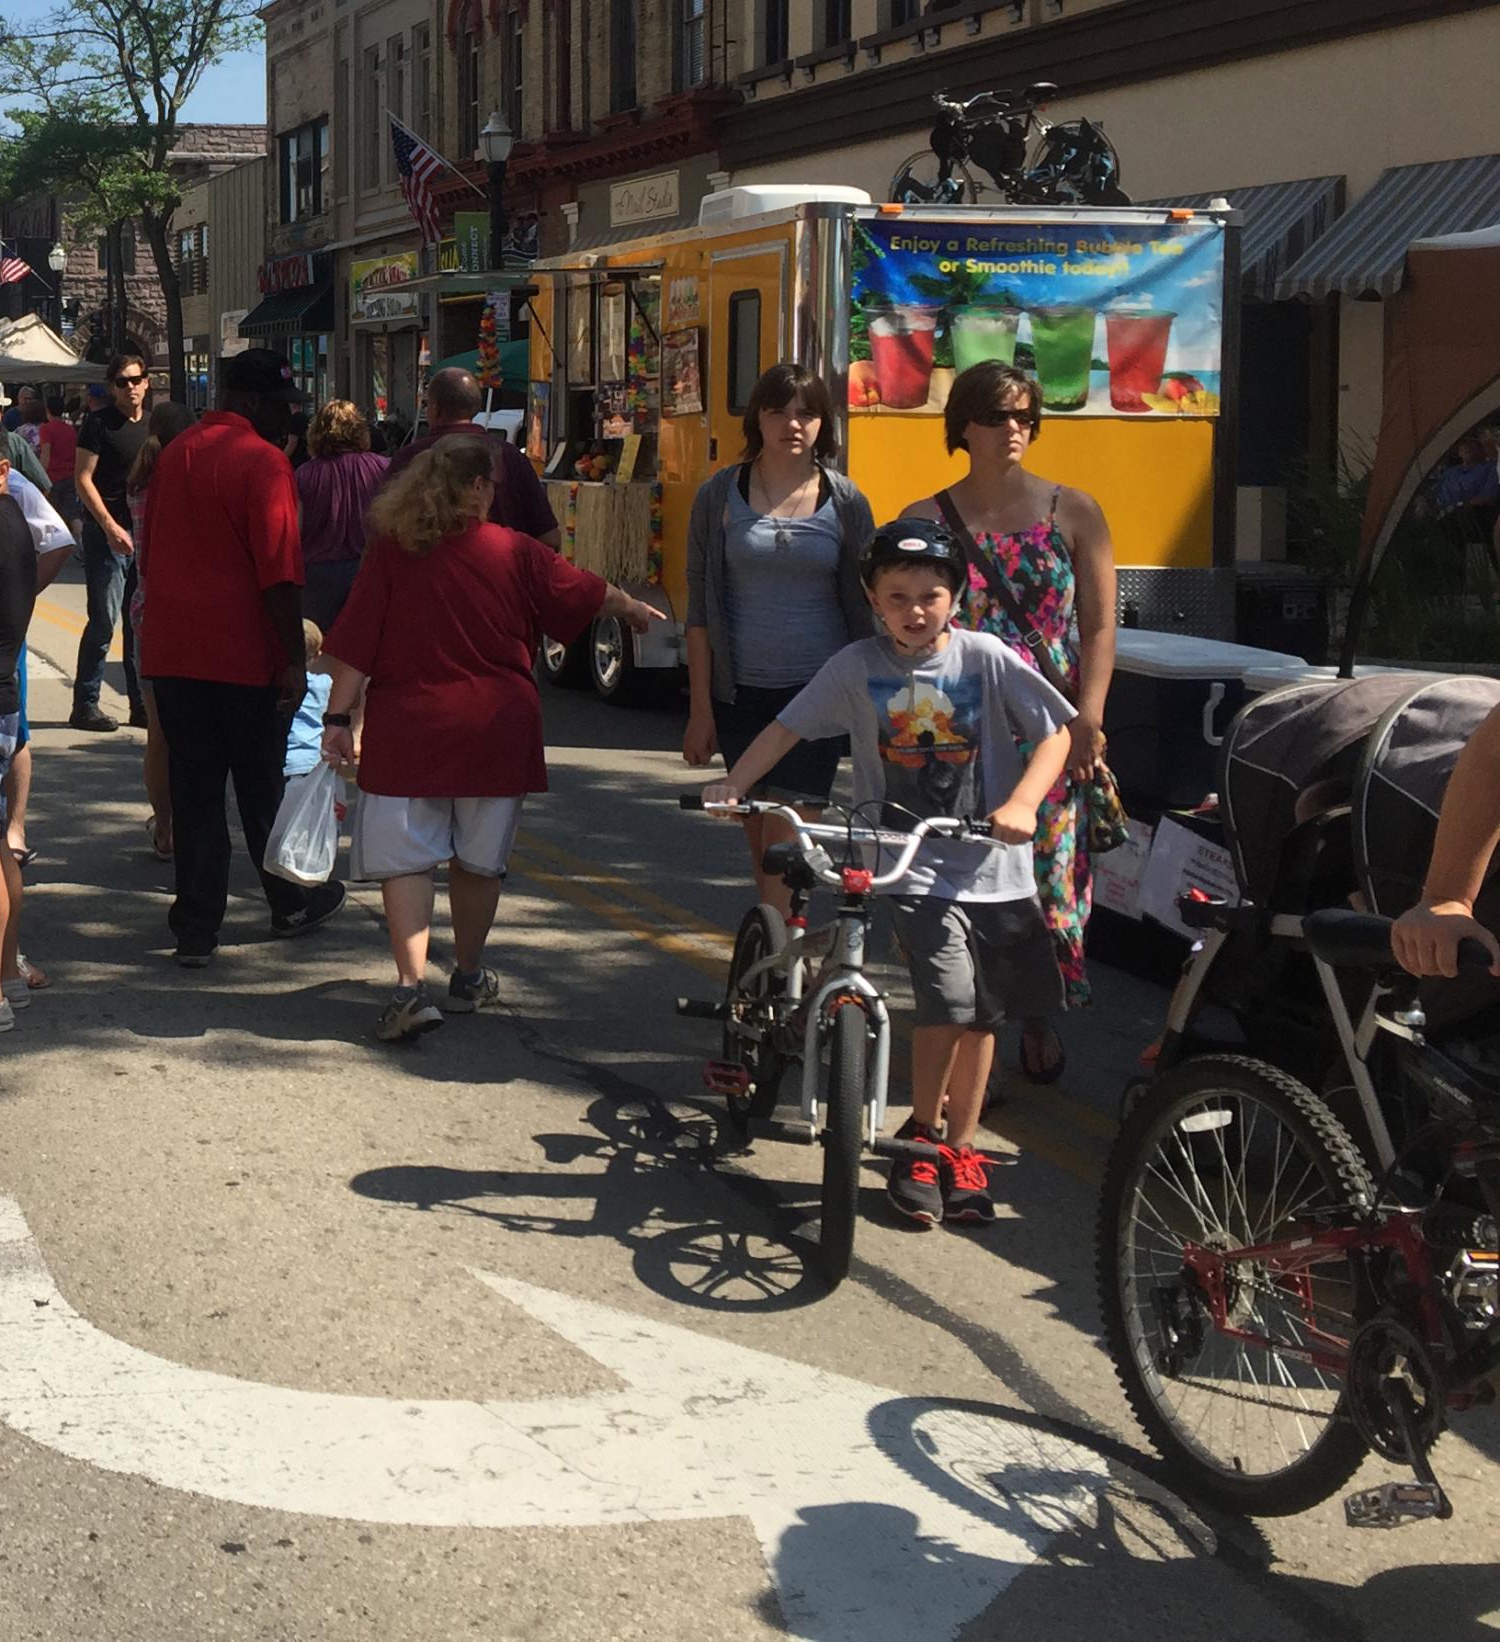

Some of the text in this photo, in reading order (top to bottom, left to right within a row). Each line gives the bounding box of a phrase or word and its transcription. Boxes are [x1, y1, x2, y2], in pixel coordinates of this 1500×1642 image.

[891, 236, 940, 254] Enjoy
[947, 240, 959, 251] a
[966, 237, 1068, 256] Refreshing
[938, 260, 960, 272] or
[965, 258, 1057, 274] Smoothie
